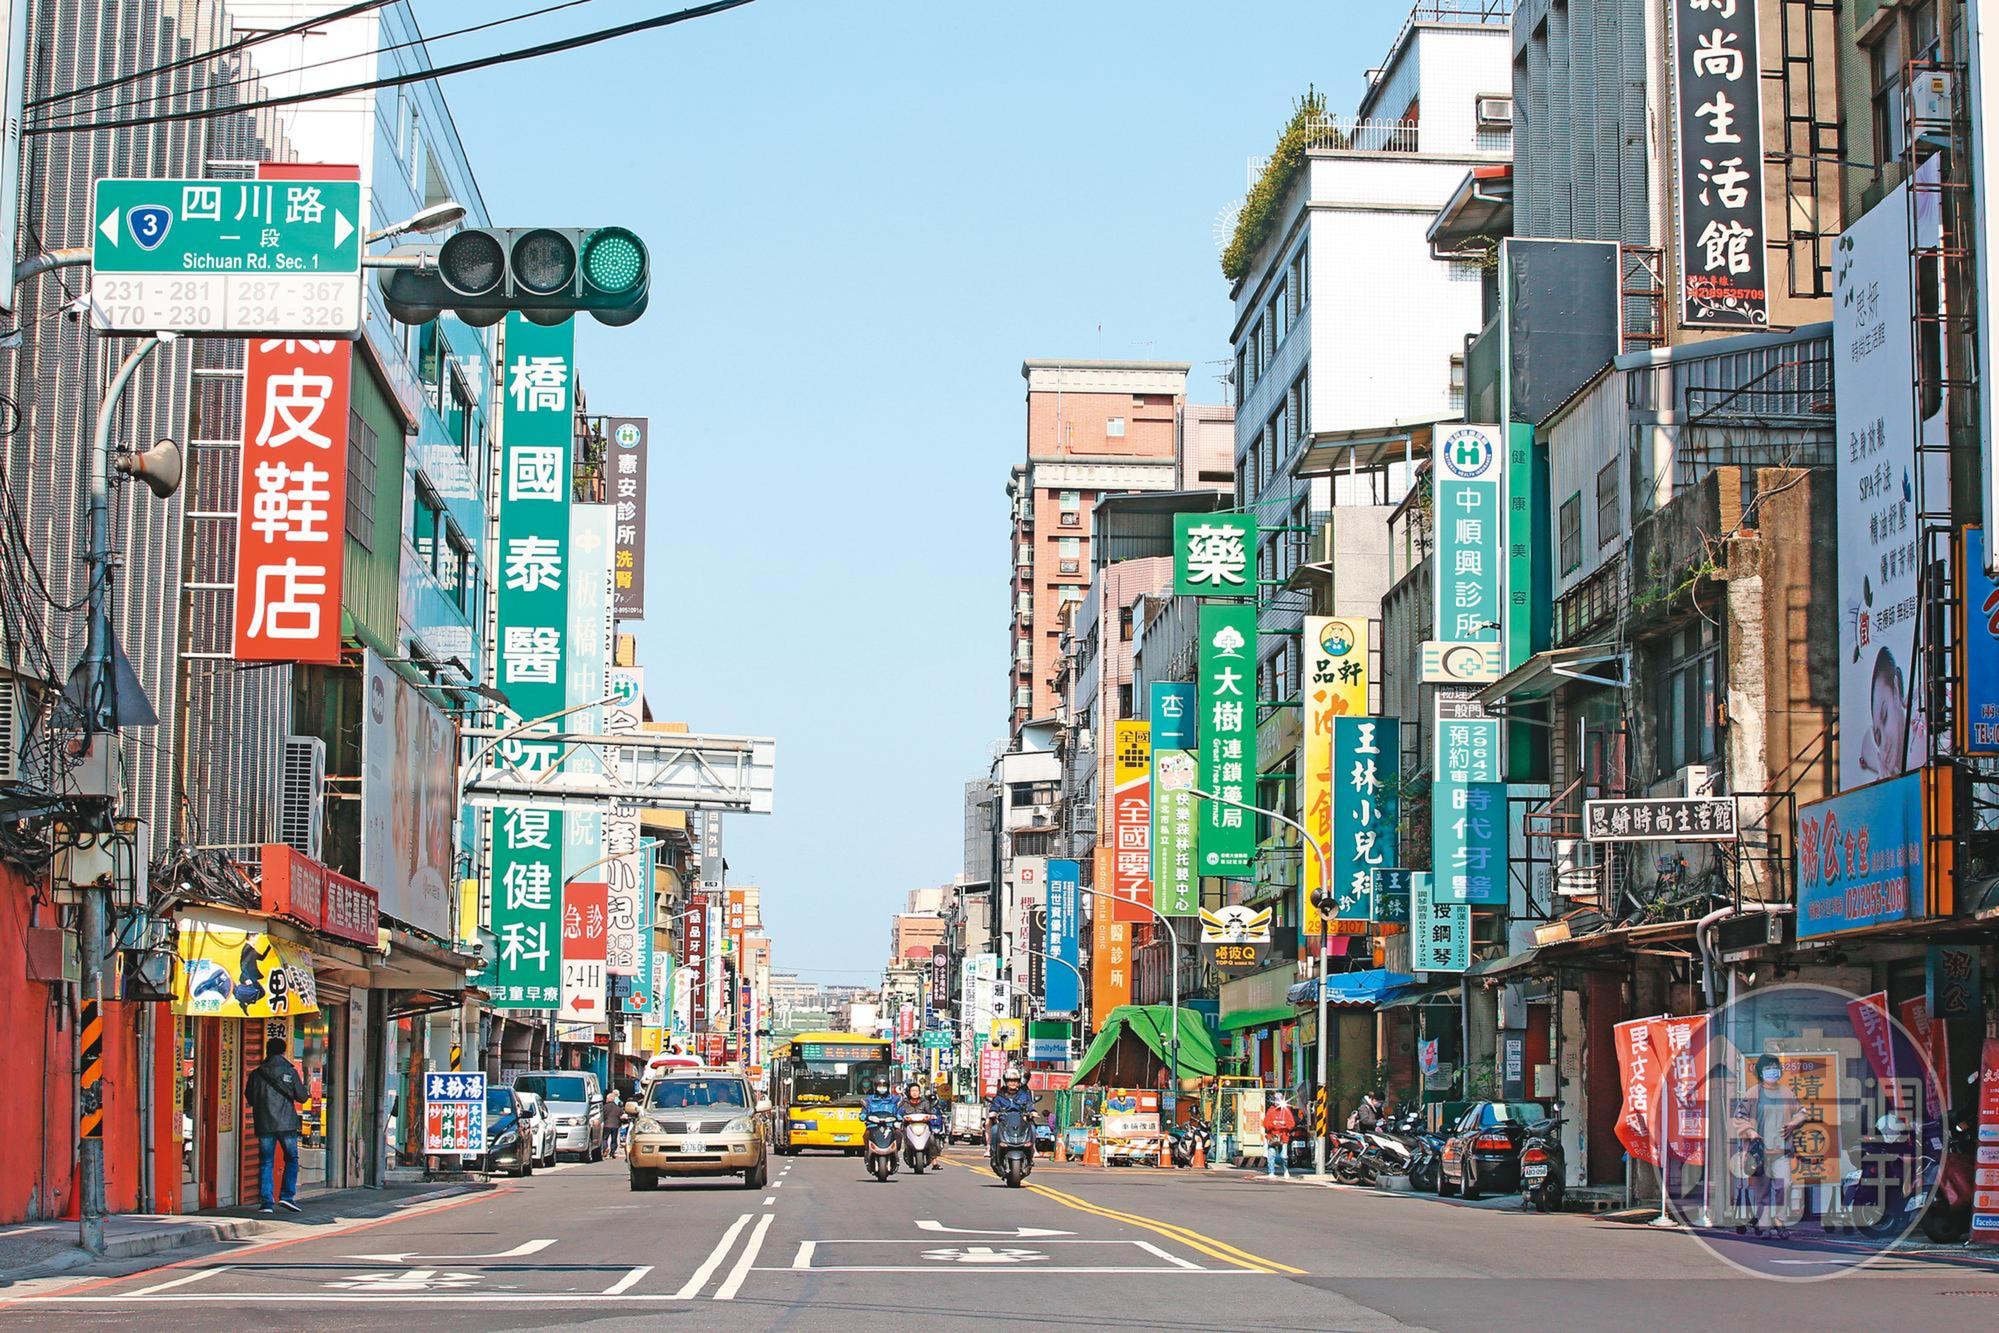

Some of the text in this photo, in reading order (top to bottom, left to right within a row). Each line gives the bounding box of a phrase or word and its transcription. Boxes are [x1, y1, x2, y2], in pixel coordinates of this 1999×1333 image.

[143, 214, 158, 236] 3
[181, 185, 326, 225] 四川路
[219, 228, 281, 249] 一段
[183, 252, 320, 270] Sichuan Rd. Sec. 1
[104, 281, 211, 302] 231 281
[238, 282, 345, 302] 287 367
[169, 306, 212, 326] 230
[237, 307, 345, 326] 234 326
[247, 339, 336, 640] 皮鞋店
[1511, 449, 1527, 606] 健康美容
[1186, 523, 1247, 586] 藥
[1454, 486, 1483, 641] 中順興診所
[501, 309, 568, 972] 橋國泰醫院復健科
[1313, 659, 1363, 687] 品軒
[1161, 693, 1185, 737] 杏一
[1212, 666, 1244, 734] 大樹
[1221, 738, 1243, 829] 連鎖藥局
[1118, 797, 1150, 902] 全國電子
[1451, 788, 1492, 899] 時代牙醫
[1801, 809, 1869, 886] 粥公食堂
[564, 903, 604, 940] 急診
[1308, 920, 1363, 933] 2952107
[566, 965, 600, 988] 24H
[1110, 923, 1125, 989] 醫診所
[442, 1104, 455, 1148] 炒牛肉
